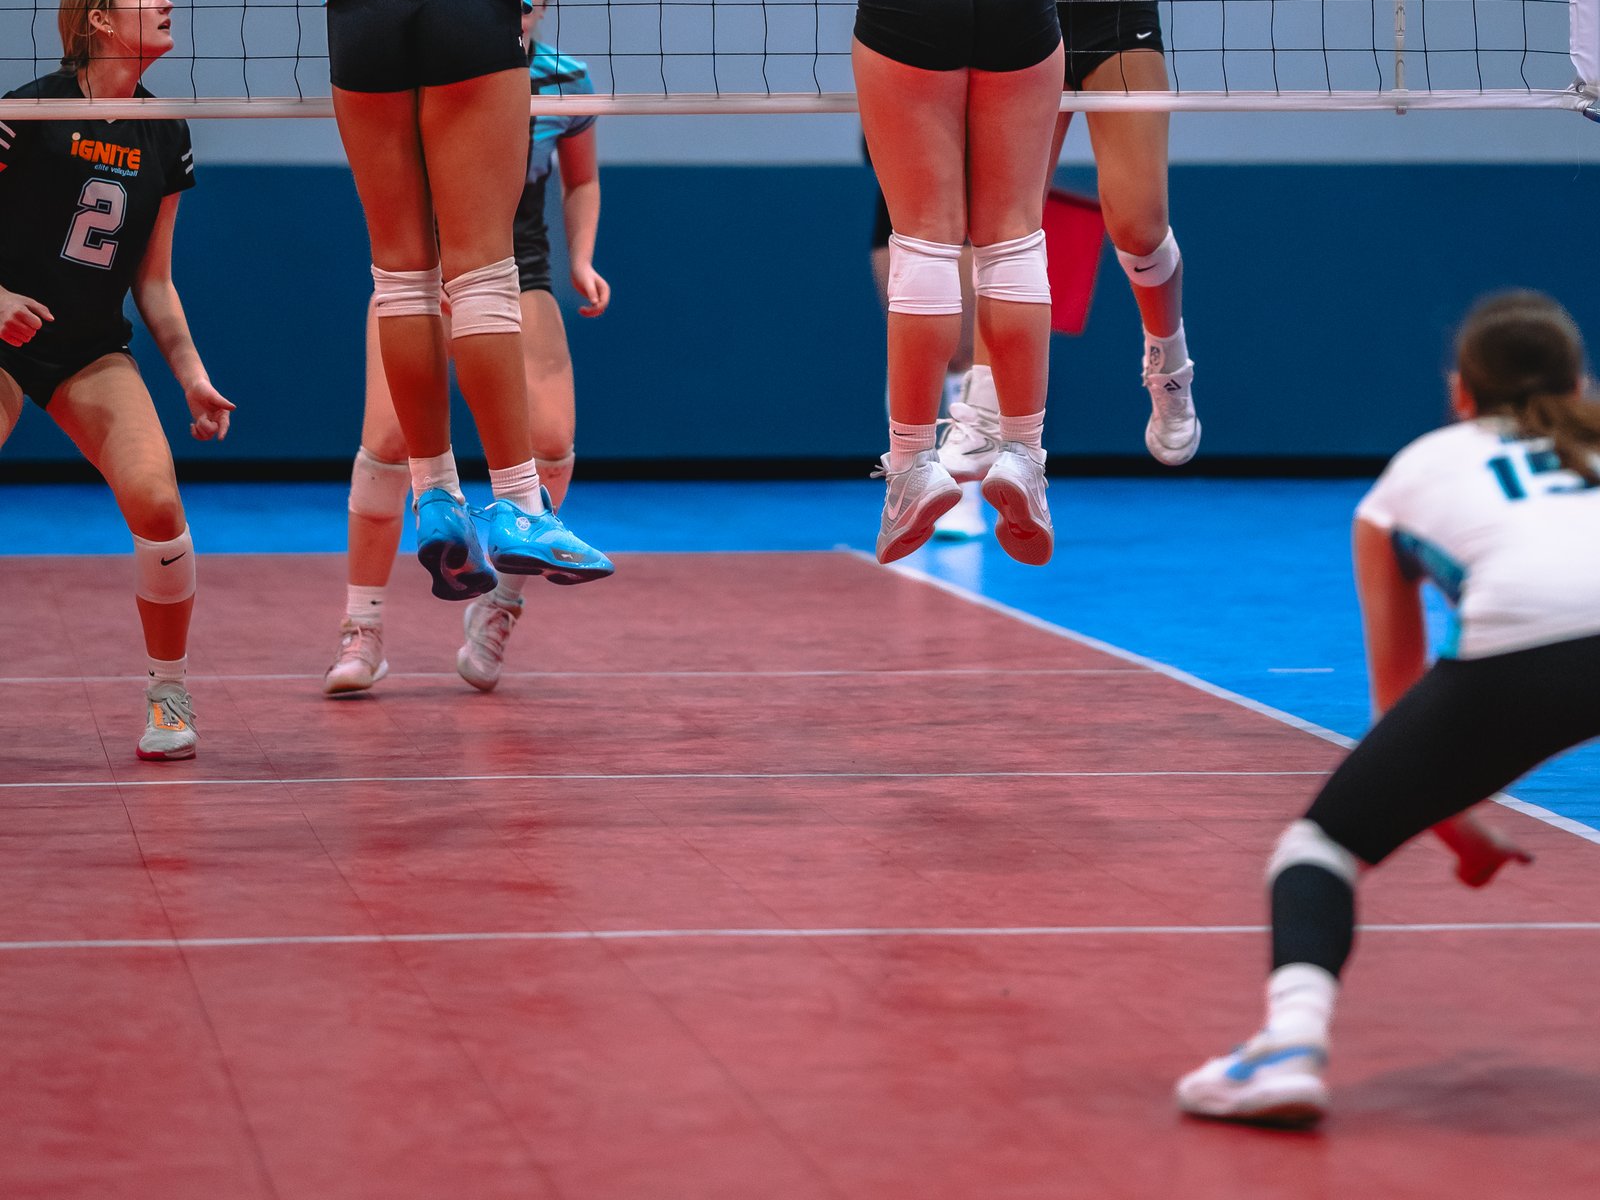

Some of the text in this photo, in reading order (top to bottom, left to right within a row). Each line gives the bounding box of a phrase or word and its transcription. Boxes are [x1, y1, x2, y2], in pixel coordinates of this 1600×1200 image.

[94, 163, 138, 177] elite volleyball
[60, 177, 127, 270] 2
